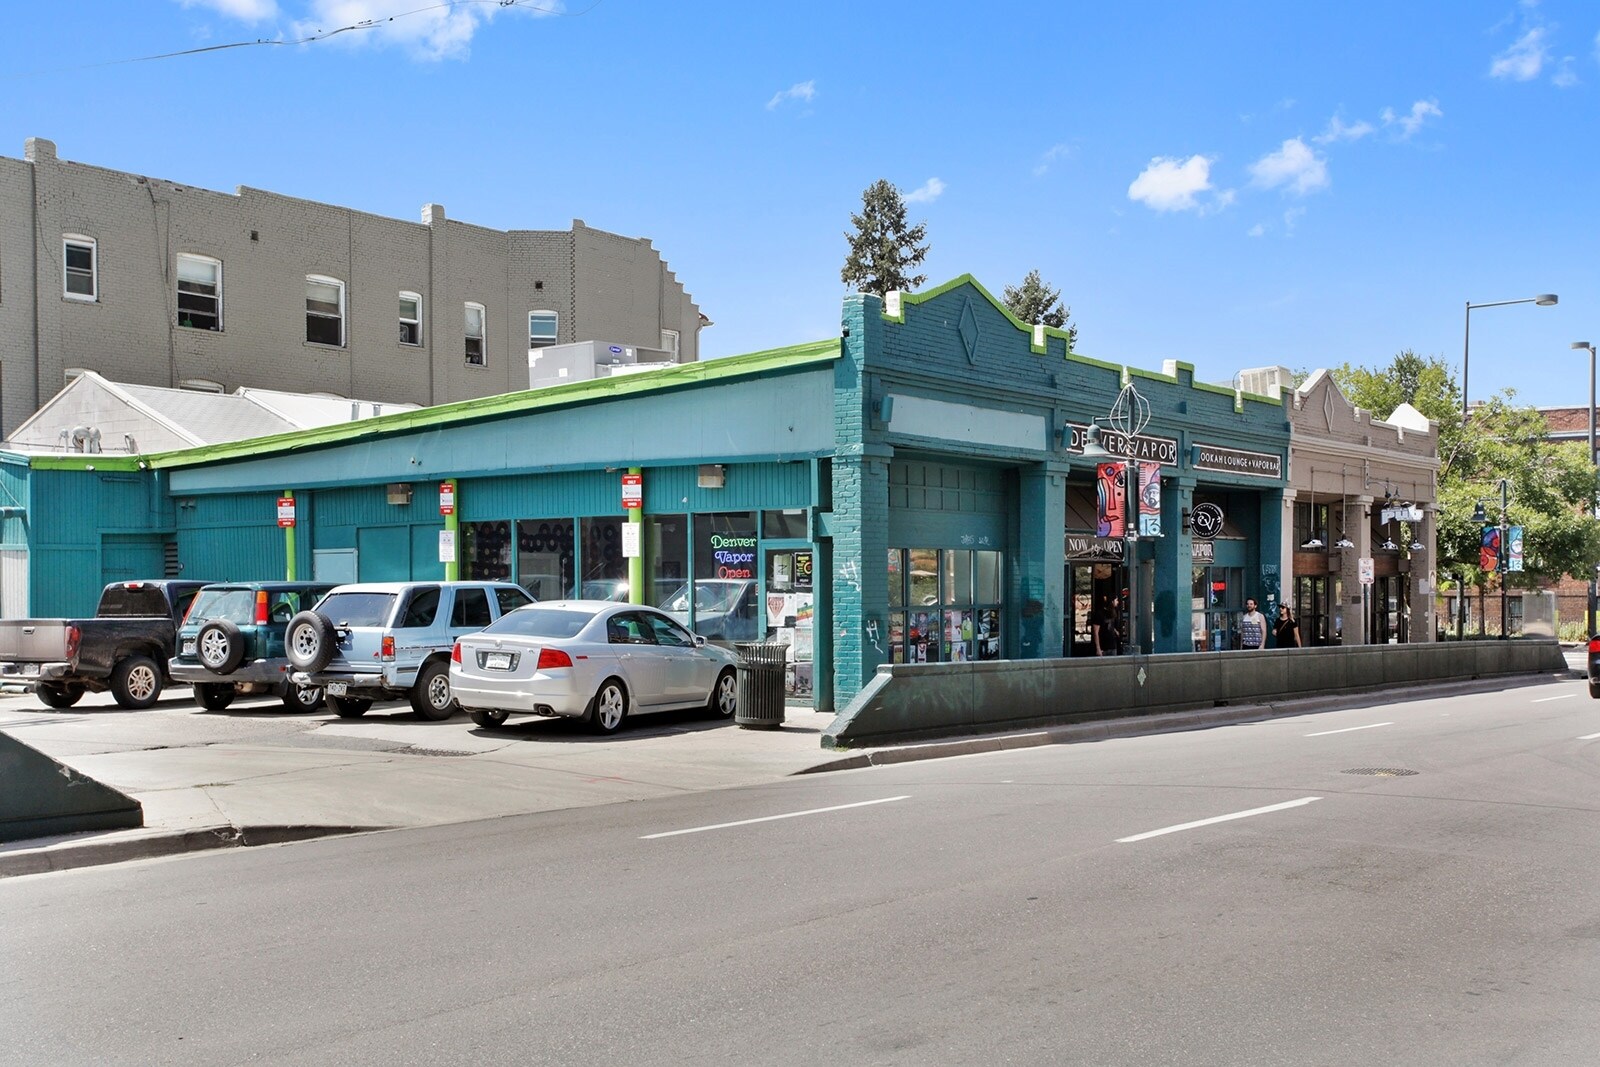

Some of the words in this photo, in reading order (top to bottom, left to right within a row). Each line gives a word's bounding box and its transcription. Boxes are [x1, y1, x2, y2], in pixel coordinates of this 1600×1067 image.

[1070, 430, 1127, 453] DEVER
[1200, 452, 1223, 464] OOKAH
[1224, 456, 1248, 468] LOUNGE
[1252, 459, 1269, 470] VAPOR
[710, 535, 757, 549] Denver
[1069, 538, 1089, 551] NOW
[1104, 540, 1123, 553] OPEN
[714, 550, 754, 565] Vapor
[718, 566, 752, 580] Open
